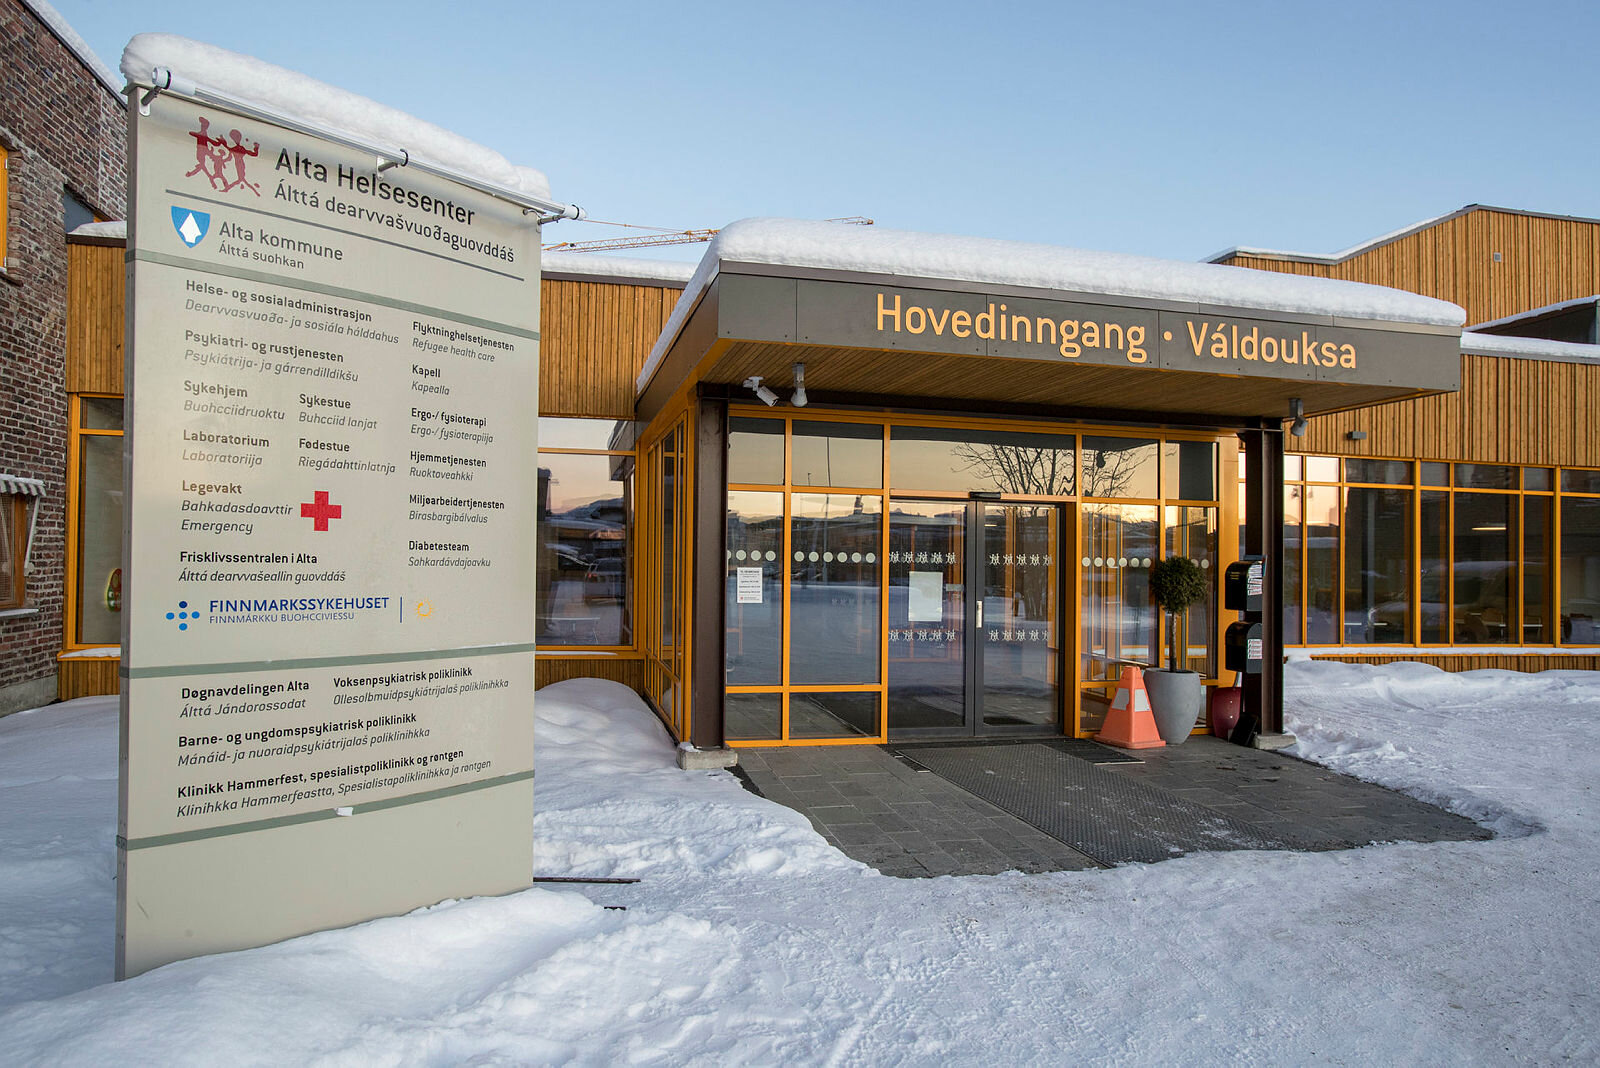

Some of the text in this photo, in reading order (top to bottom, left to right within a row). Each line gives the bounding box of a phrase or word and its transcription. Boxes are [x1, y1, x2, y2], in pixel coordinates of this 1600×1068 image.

[275, 179, 319, 208] Álttá
[276, 148, 475, 224] Alta Helsesenter
[219, 221, 343, 260] Alta kommune
[219, 240, 304, 269] Álttá suohkan
[186, 280, 372, 322] Helse- og sosialadministrasjon
[290, 316, 302, 329] ja
[304, 318, 344, 334] sosiála
[347, 326, 399, 344] hálddahus
[413, 322, 514, 352] Flyktninghelsetjenesten
[876, 293, 1356, 368] Hovedinngang Váldouksa
[185, 330, 344, 363] Psykiatri- og rustjenesten
[412, 338, 495, 362] Refugee health care
[184, 350, 359, 382] Psykiátrija- ja gárrendilldikšu
[412, 364, 441, 378] Kapell
[184, 380, 248, 398] Sykehjem
[412, 381, 450, 395] Kapealla
[183, 400, 285, 420] Buohcciidruoktu
[299, 394, 351, 409] Sykestue
[299, 412, 377, 431] Buhcciid lanjat
[441, 412, 486, 428] fysioterapi
[183, 429, 270, 448] Laboratorium
[299, 438, 350, 452] Fødestue
[439, 427, 493, 444] fysioterapiija
[182, 449, 263, 468] Laboratoriija
[298, 456, 396, 475] Riegádahttinlatnja
[410, 451, 486, 467] Hjemmetjenesten
[410, 467, 474, 481] Ruoktoveahkki
[182, 480, 242, 496] Legevakt
[181, 500, 293, 515] Bahkadasdoavttir
[409, 494, 505, 510] Miljøarbeidertjenesten
[181, 520, 253, 535] Emergency
[408, 541, 469, 552] Diabetesteam
[180, 551, 317, 564] Frisklivssentralen i Alta
[179, 570, 346, 584] Álttá dearvvašeallin guovddáš
[210, 597, 390, 612] FINNMARKSSYKEHUSET
[210, 612, 354, 624] FINNMÁRKKU BUOHCCIVIESSU
[334, 667, 472, 688] Voksenpsykiatrisk poliklinikk
[460, 679, 508, 694] poliklinihkka
[181, 681, 309, 701] Døgnavdelingen Alta
[180, 699, 306, 718] Álttá Jándorossodat
[178, 713, 416, 747] Barne- og ungdomspsykiatrisk poliklinikk
[178, 728, 430, 767] Mánáid- ja nuoraidpsykiátrijalaš poliklinihkka
[178, 750, 464, 798] Klinikk Hammerfest, spesialistpoliklinikk og røntgen
[177, 760, 491, 817] Klinihkka Hammerfeastta, Spesialistapoliklinihkka ja røntgen
